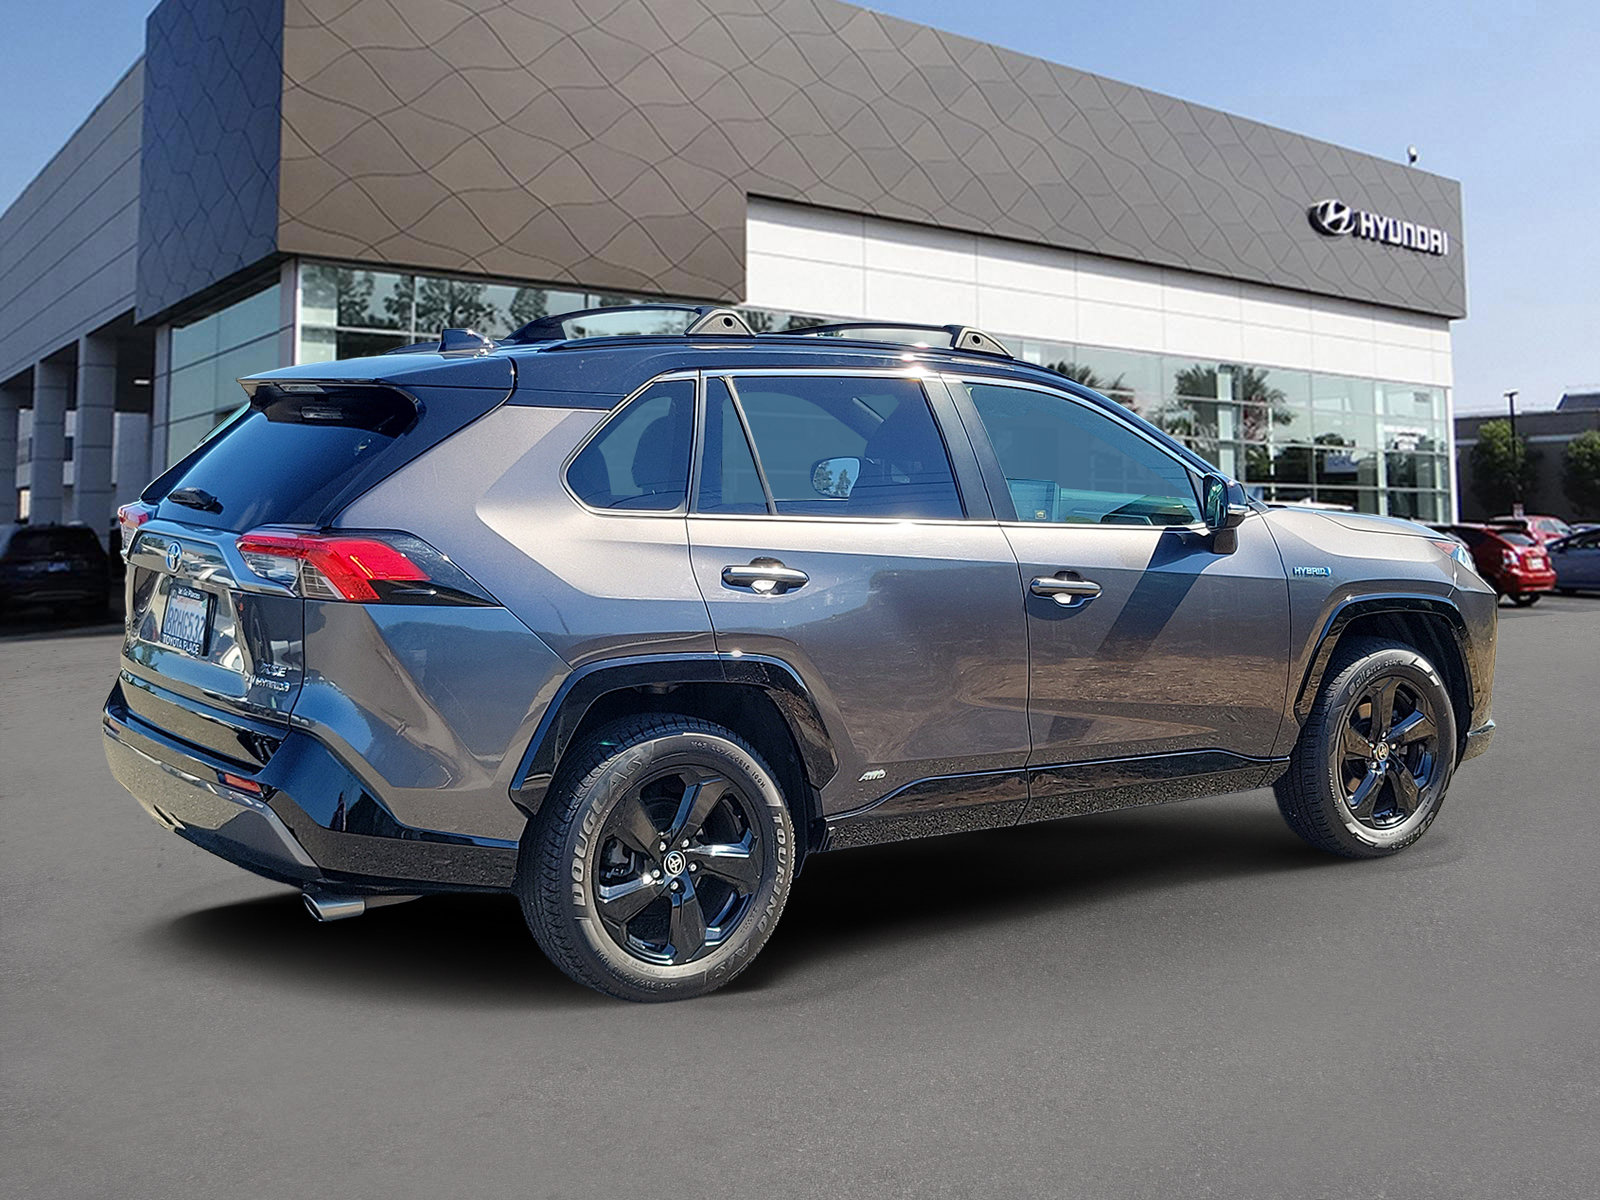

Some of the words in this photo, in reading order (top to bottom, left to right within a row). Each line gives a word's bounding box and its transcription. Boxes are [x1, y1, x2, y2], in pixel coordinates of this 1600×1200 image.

[1360, 211, 1449, 255] HYUNDAI
[1294, 566, 1327, 576] HYBRID
[163, 634, 182, 650] TOYOTA
[183, 640, 200, 655] PLACE
[858, 769, 887, 782] AWD
[571, 753, 643, 907] DOUGLAS
[756, 813, 788, 933] TOURING
